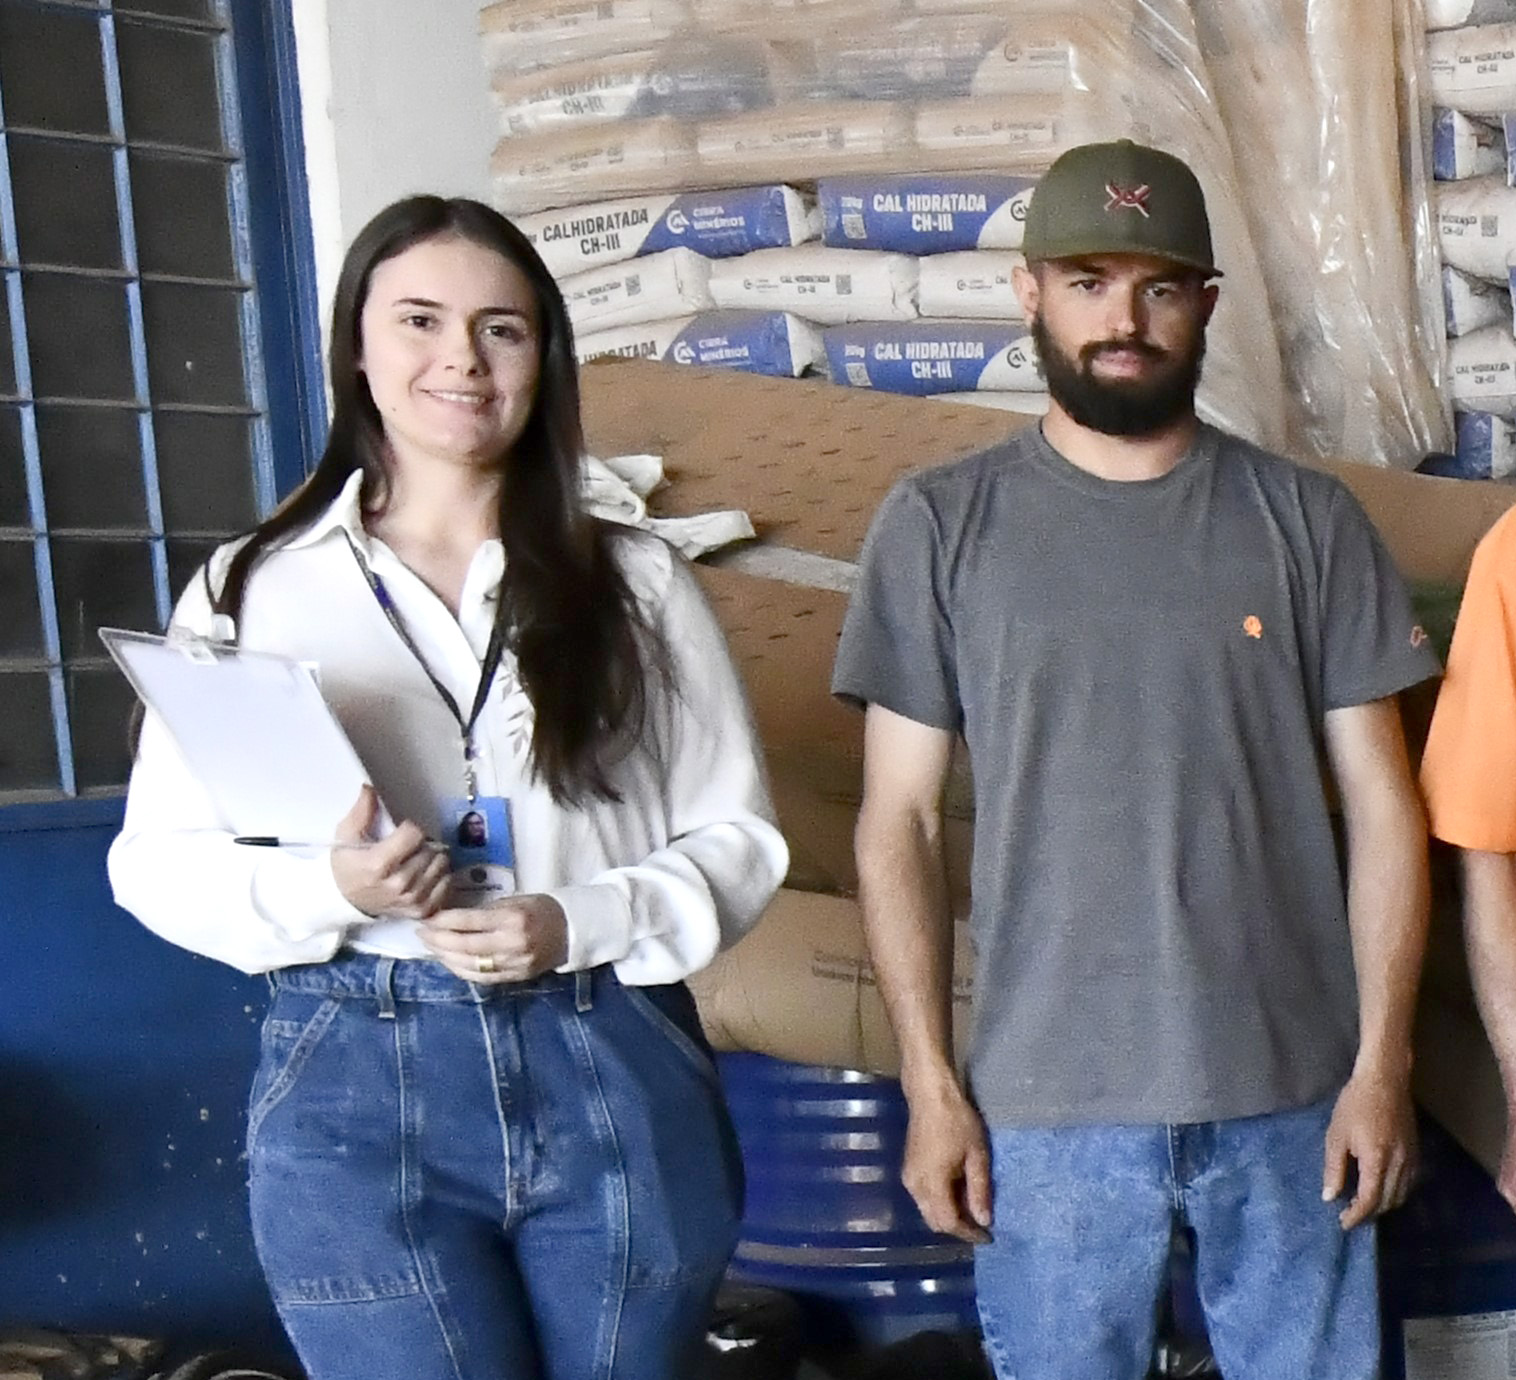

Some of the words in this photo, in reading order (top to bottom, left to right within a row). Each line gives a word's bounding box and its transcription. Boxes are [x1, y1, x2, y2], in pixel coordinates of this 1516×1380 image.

[873, 194, 903, 213] CAL
[906, 194, 987, 213] HIDRATADA
[911, 213, 953, 232] CH-III
[580, 234, 621, 256] CH-III
[874, 343, 902, 361] CAL
[906, 342, 985, 360] HIDRATADA
[911, 361, 952, 379] CH-III
